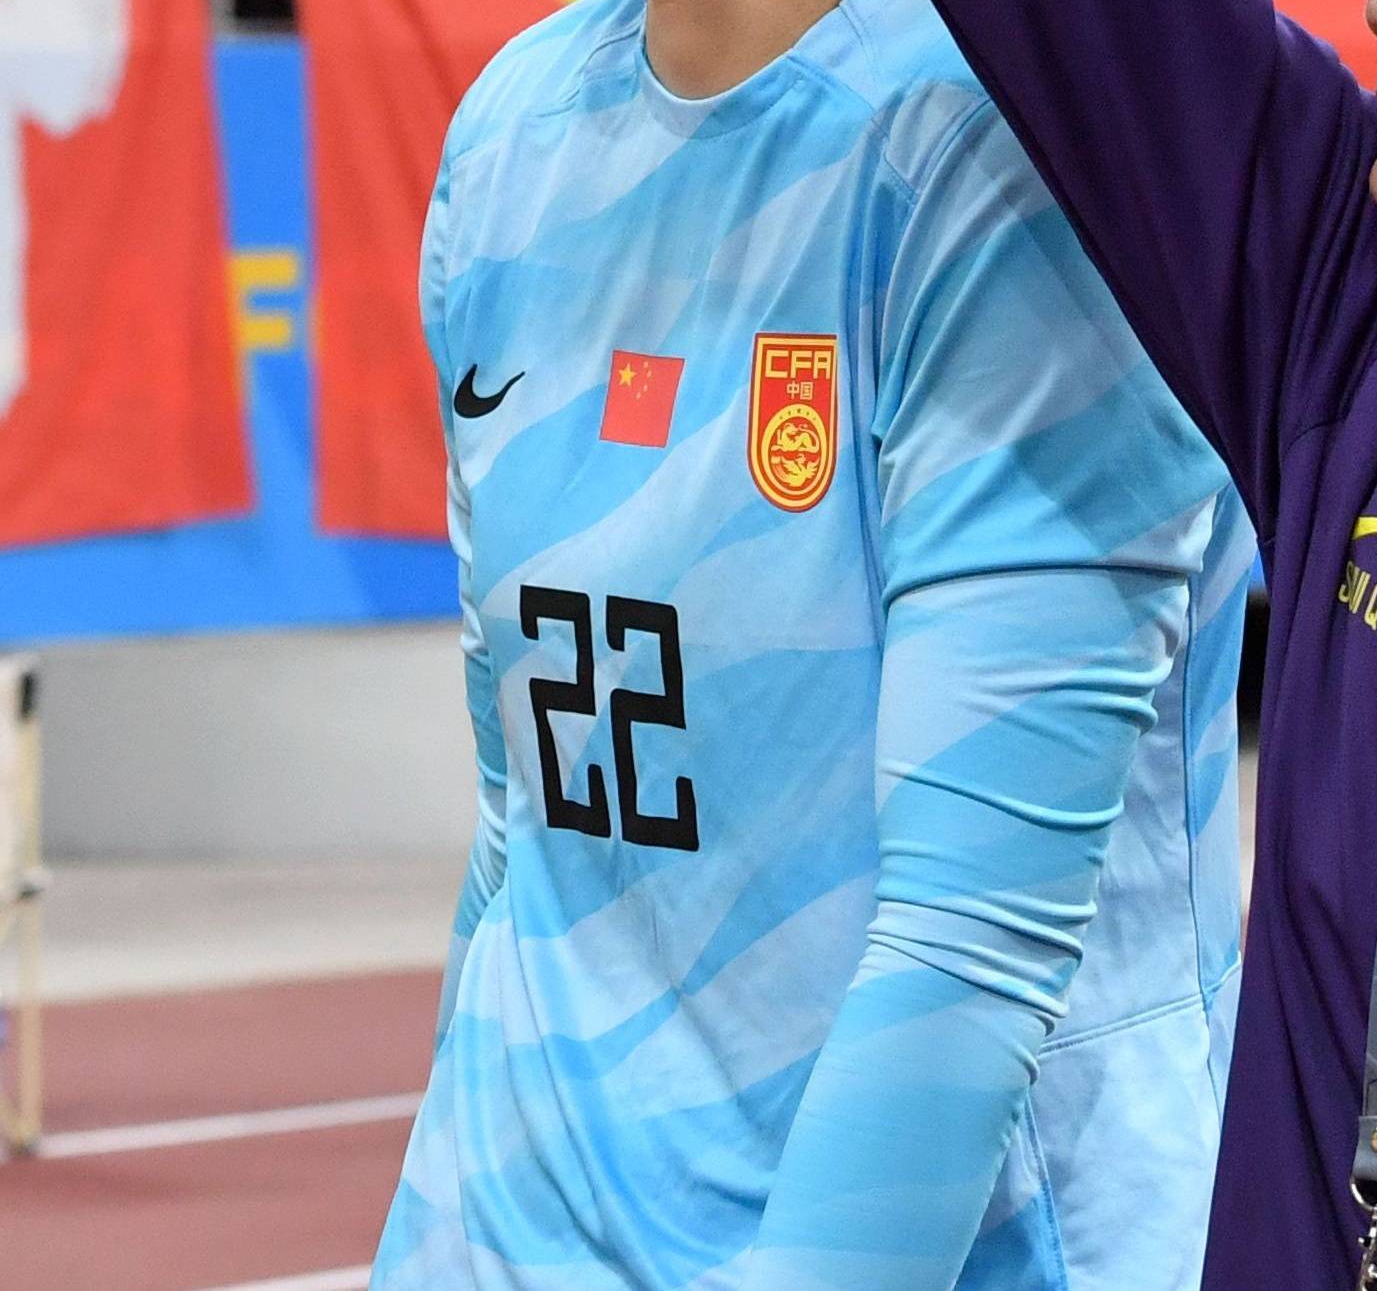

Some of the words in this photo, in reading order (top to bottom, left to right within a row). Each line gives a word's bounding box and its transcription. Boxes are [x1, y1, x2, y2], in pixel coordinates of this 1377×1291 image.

[765, 349, 832, 380] CFA
[786, 379, 814, 401] 中国
[520, 584, 699, 851] 22
